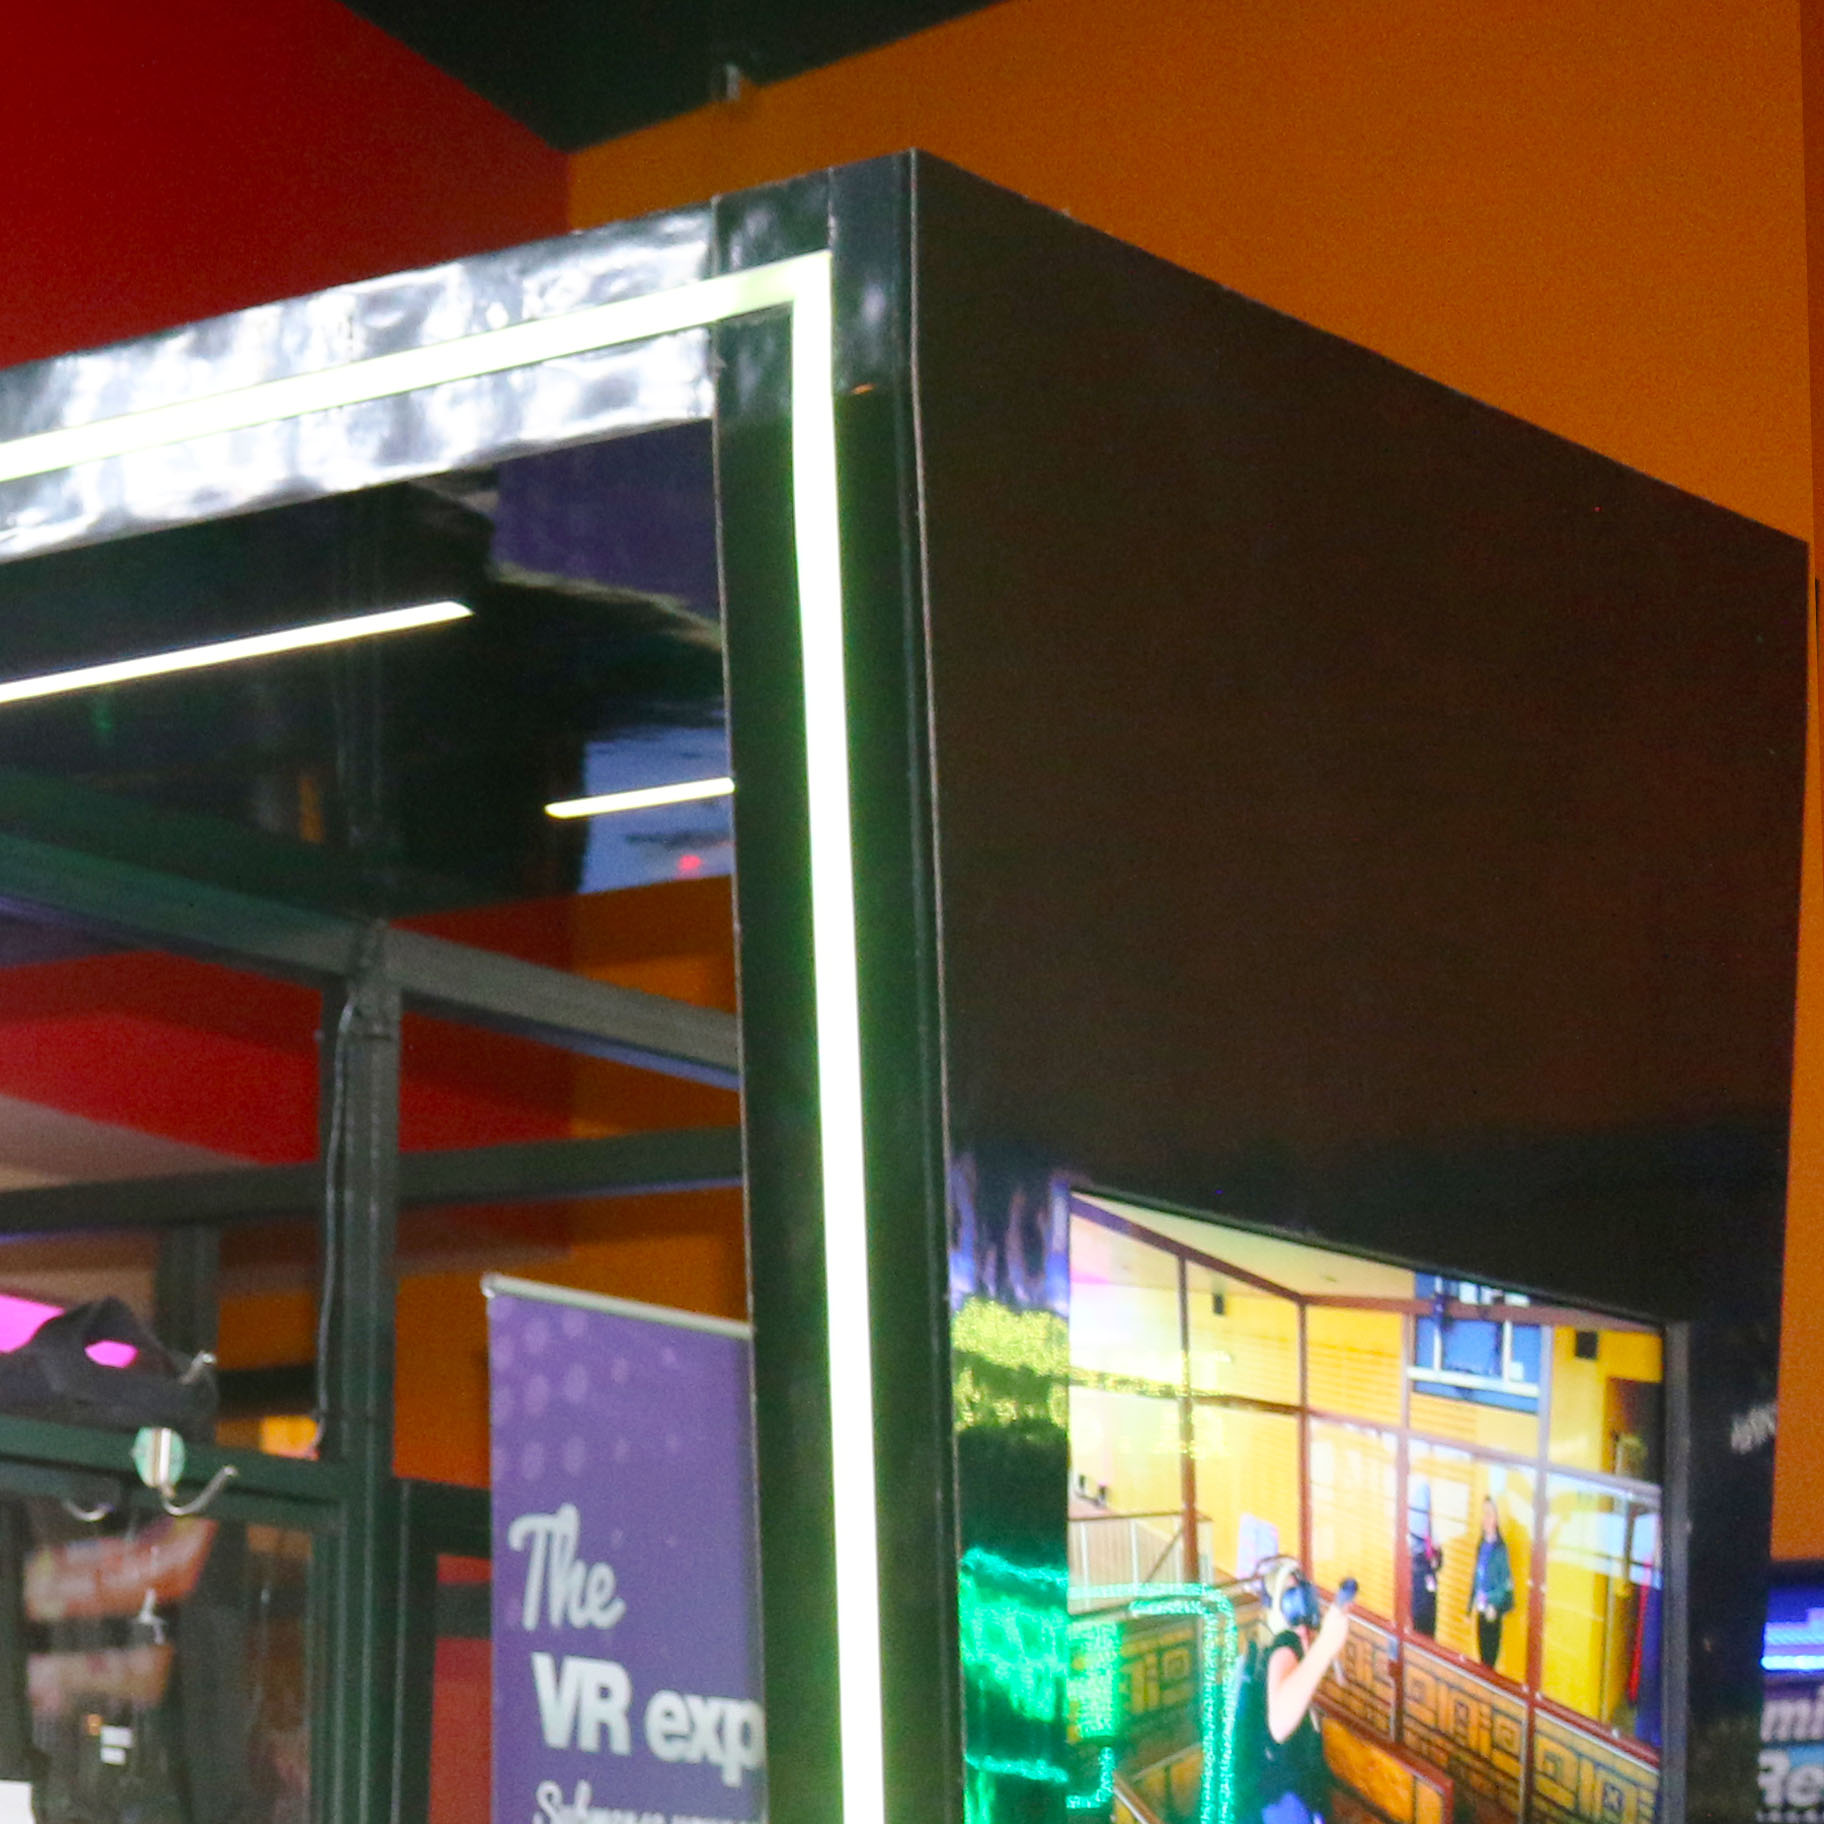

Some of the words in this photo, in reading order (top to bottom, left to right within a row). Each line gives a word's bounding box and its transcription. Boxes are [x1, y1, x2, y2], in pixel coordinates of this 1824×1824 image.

[508, 1503, 627, 1632] The
[531, 1651, 633, 1757] VR
[644, 1688, 766, 1788] exp
